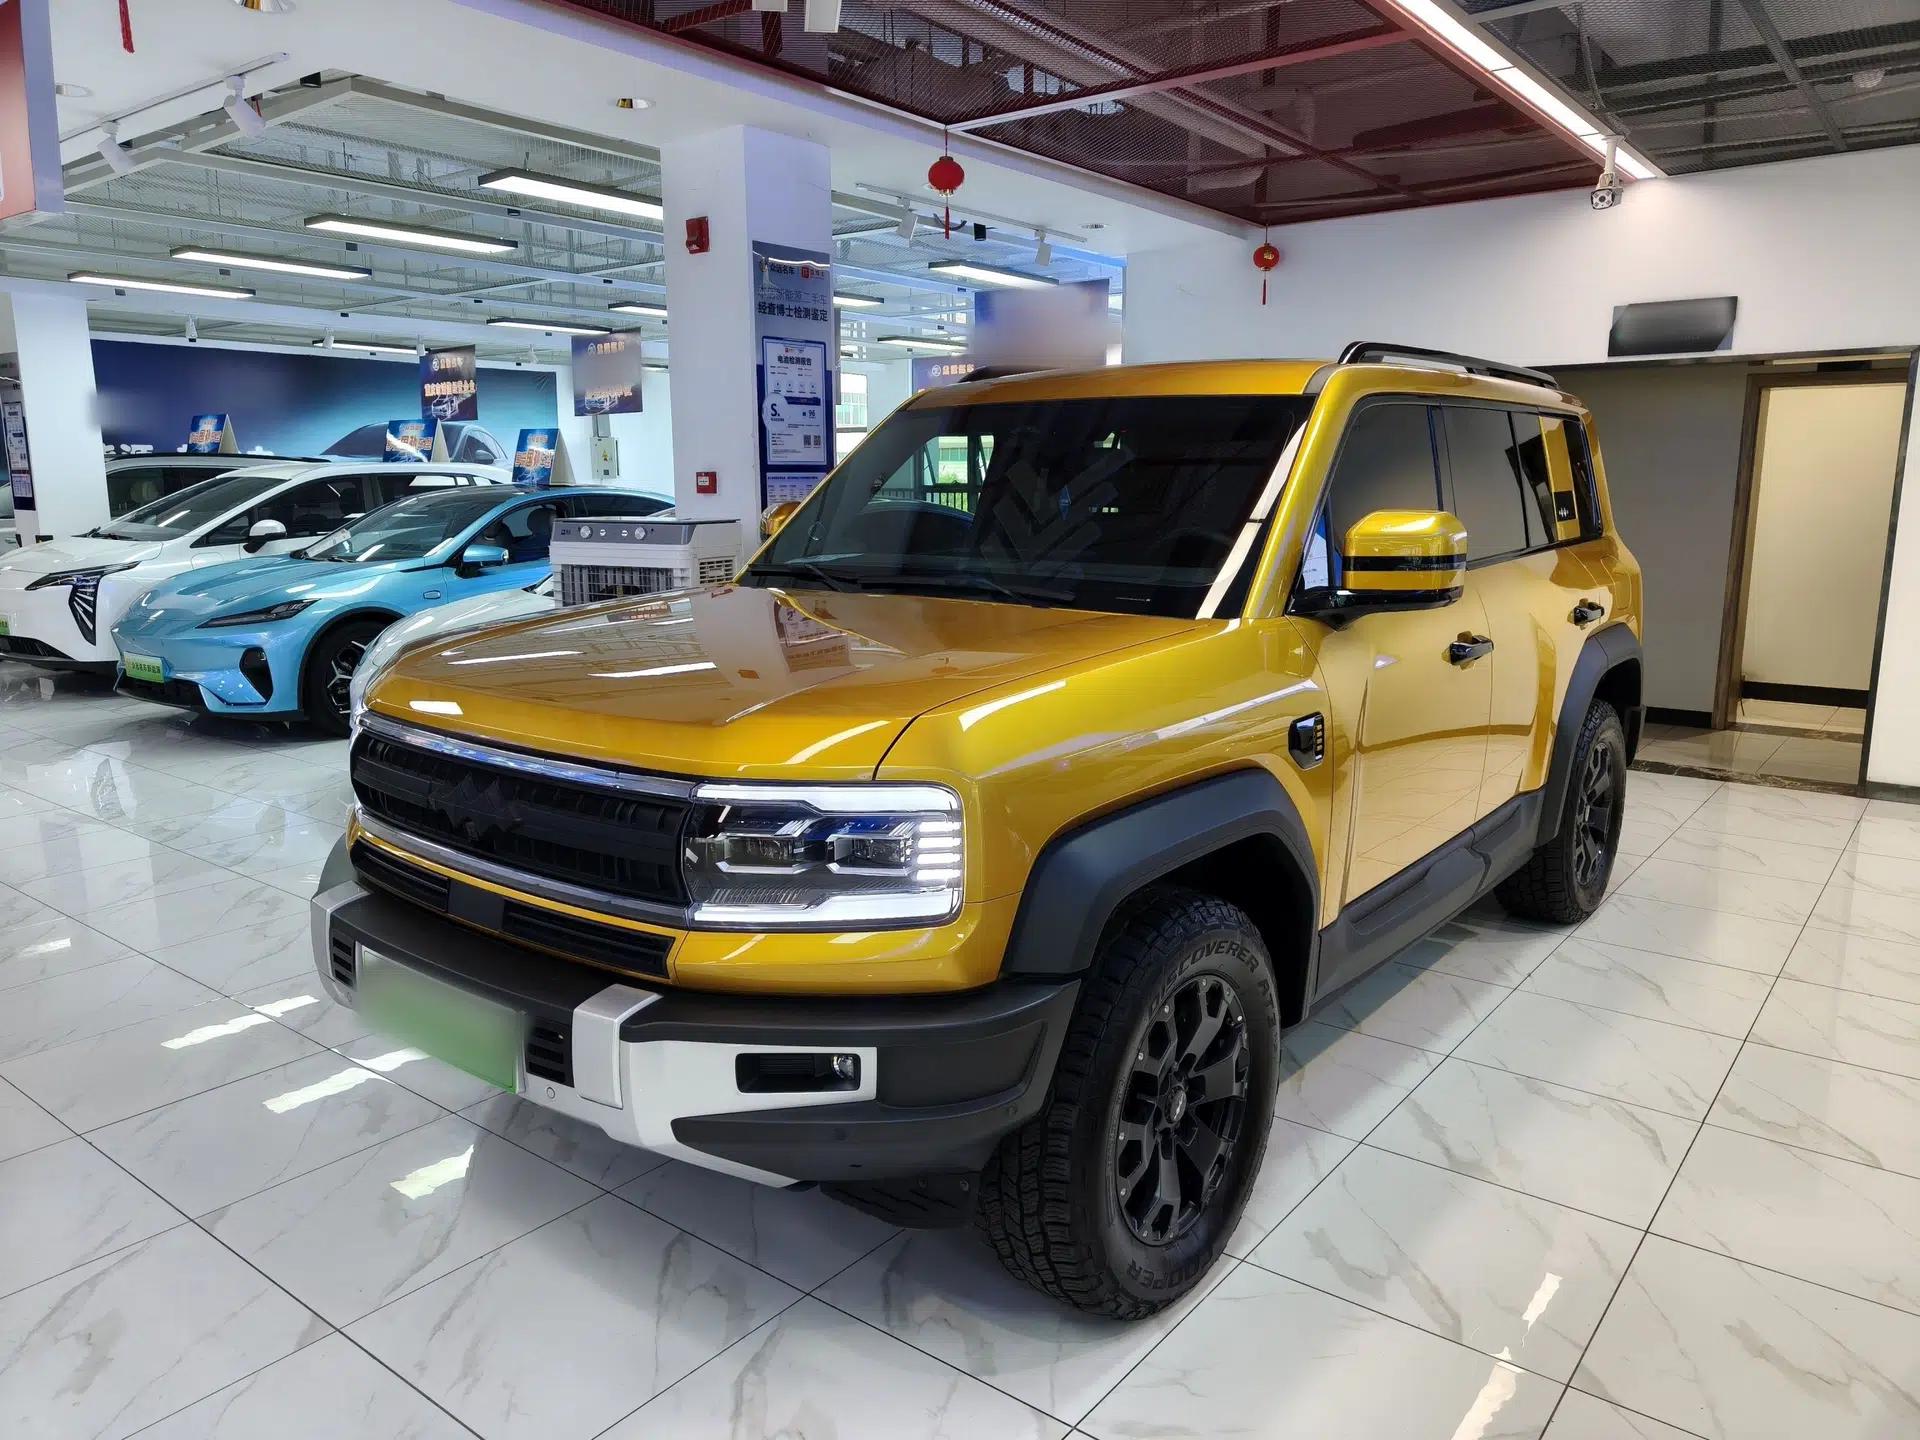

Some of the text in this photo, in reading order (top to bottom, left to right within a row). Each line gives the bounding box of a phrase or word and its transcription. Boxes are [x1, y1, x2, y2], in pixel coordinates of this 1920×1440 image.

[758, 302, 829, 321] 经查博士检测鉴定
